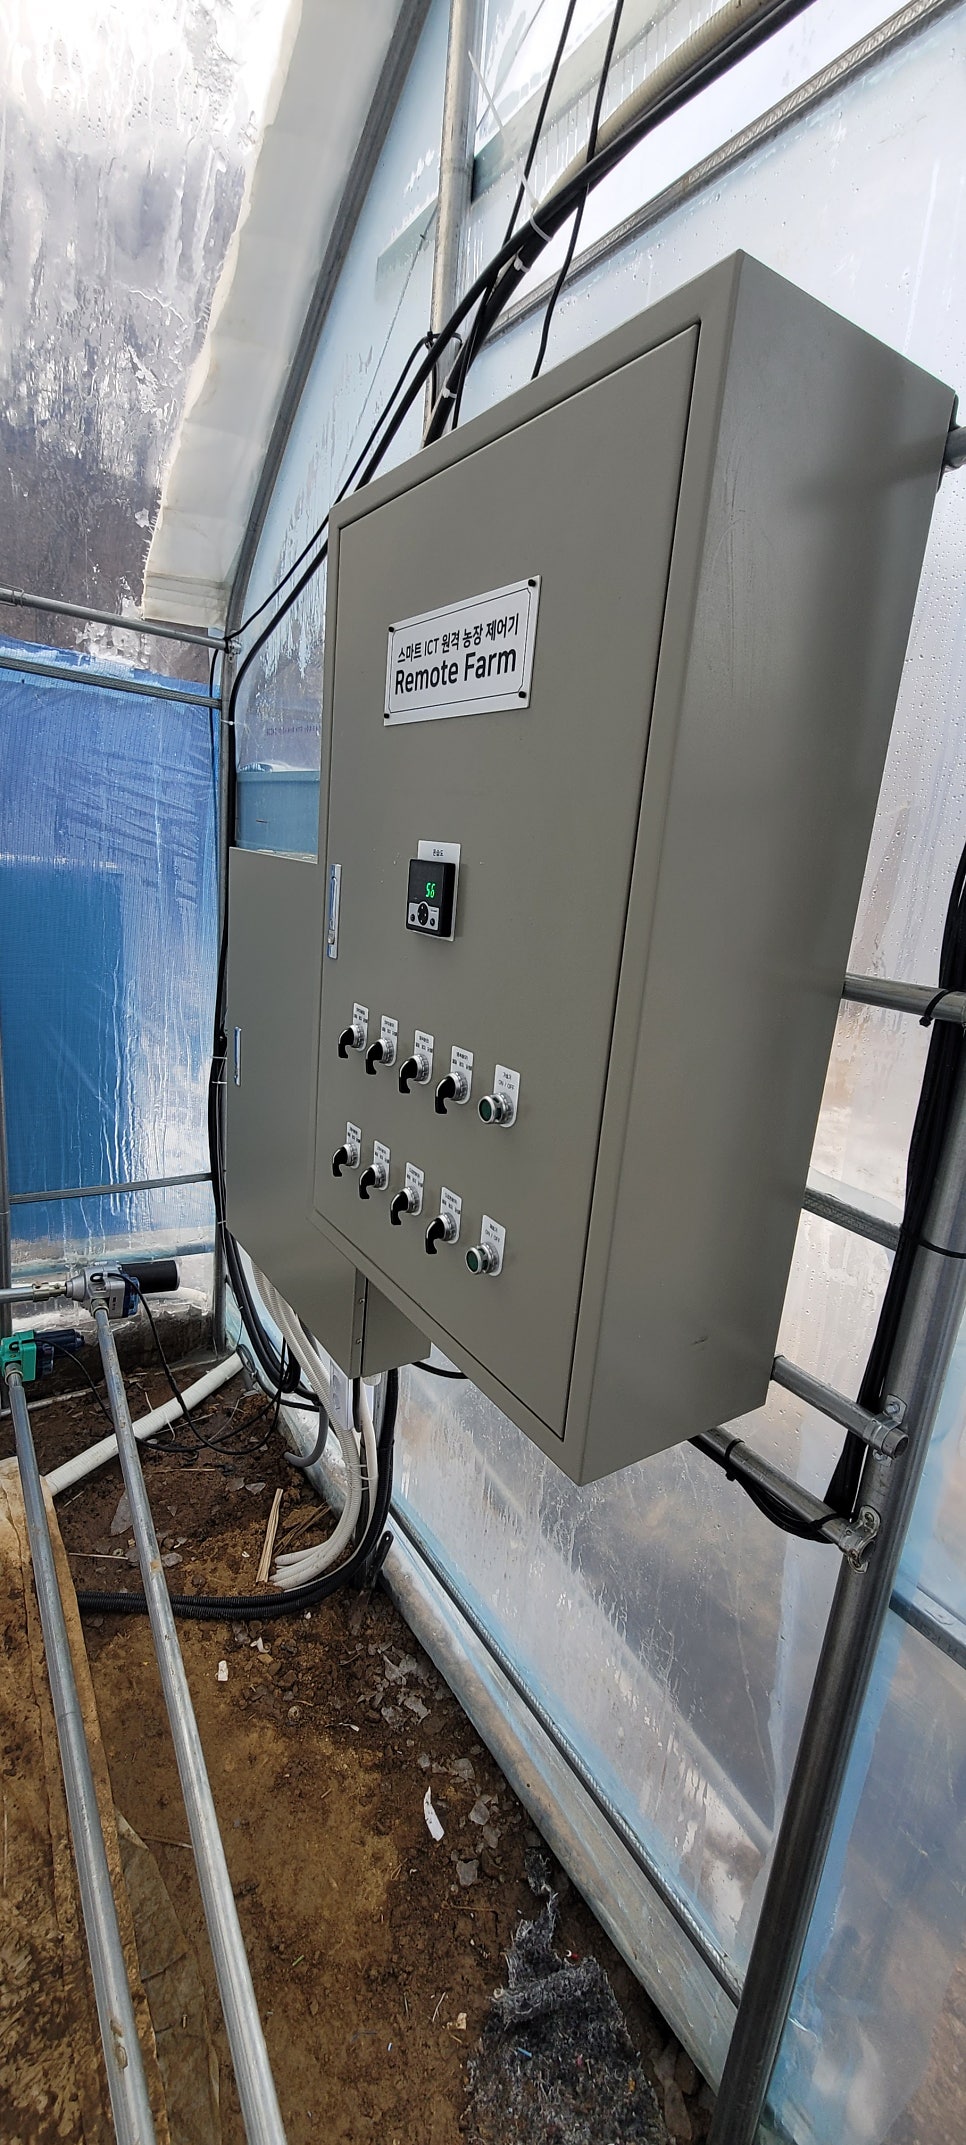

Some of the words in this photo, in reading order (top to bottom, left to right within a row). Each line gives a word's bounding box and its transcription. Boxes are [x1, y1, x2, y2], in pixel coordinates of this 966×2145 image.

[397, 642, 422, 664] 스마트
[424, 637, 440, 657] ICT
[441, 629, 460, 654] 원격
[462, 623, 484, 649] 농장
[485, 612, 520, 641] 제어기
[394, 659, 459, 695] Remote
[463, 648, 517, 682] Farm
[425, 882, 436, 898] 56
